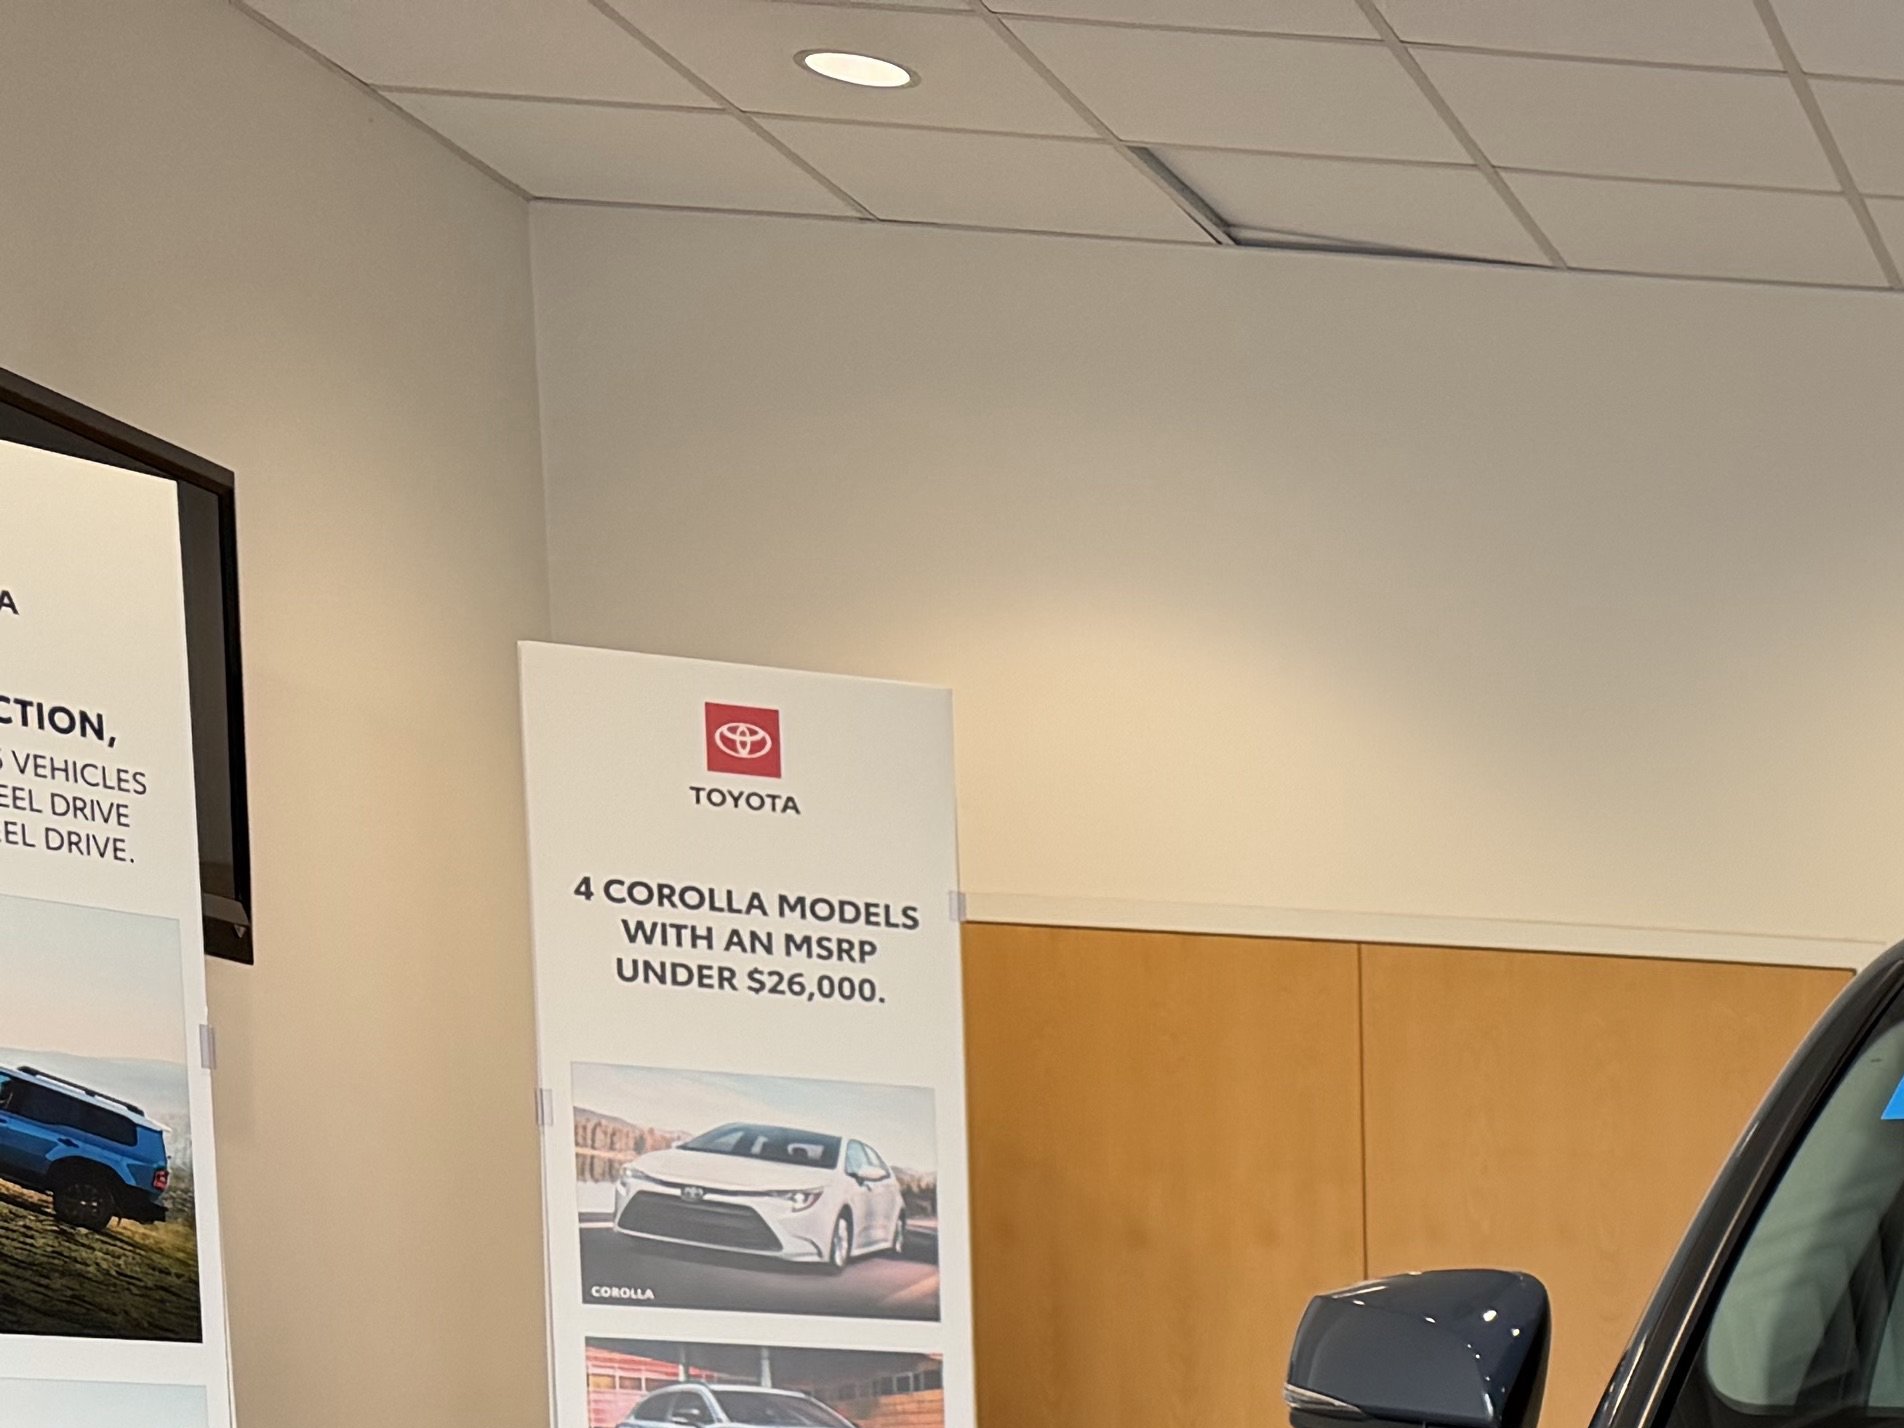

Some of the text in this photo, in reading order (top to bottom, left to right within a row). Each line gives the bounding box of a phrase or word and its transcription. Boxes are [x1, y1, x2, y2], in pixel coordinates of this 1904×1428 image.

[12, 750, 147, 795] VEHICLES
[50, 792, 130, 828] DRIVE
[689, 786, 801, 815] TOYOTA
[45, 827, 134, 863] DRIVE.
[574, 876, 920, 930] 4 COROLLA MODELS
[621, 918, 878, 964] WITH AN MSRP
[616, 957, 886, 1003] UNDER $26,000.
[591, 1285, 655, 1300] COROLLA
